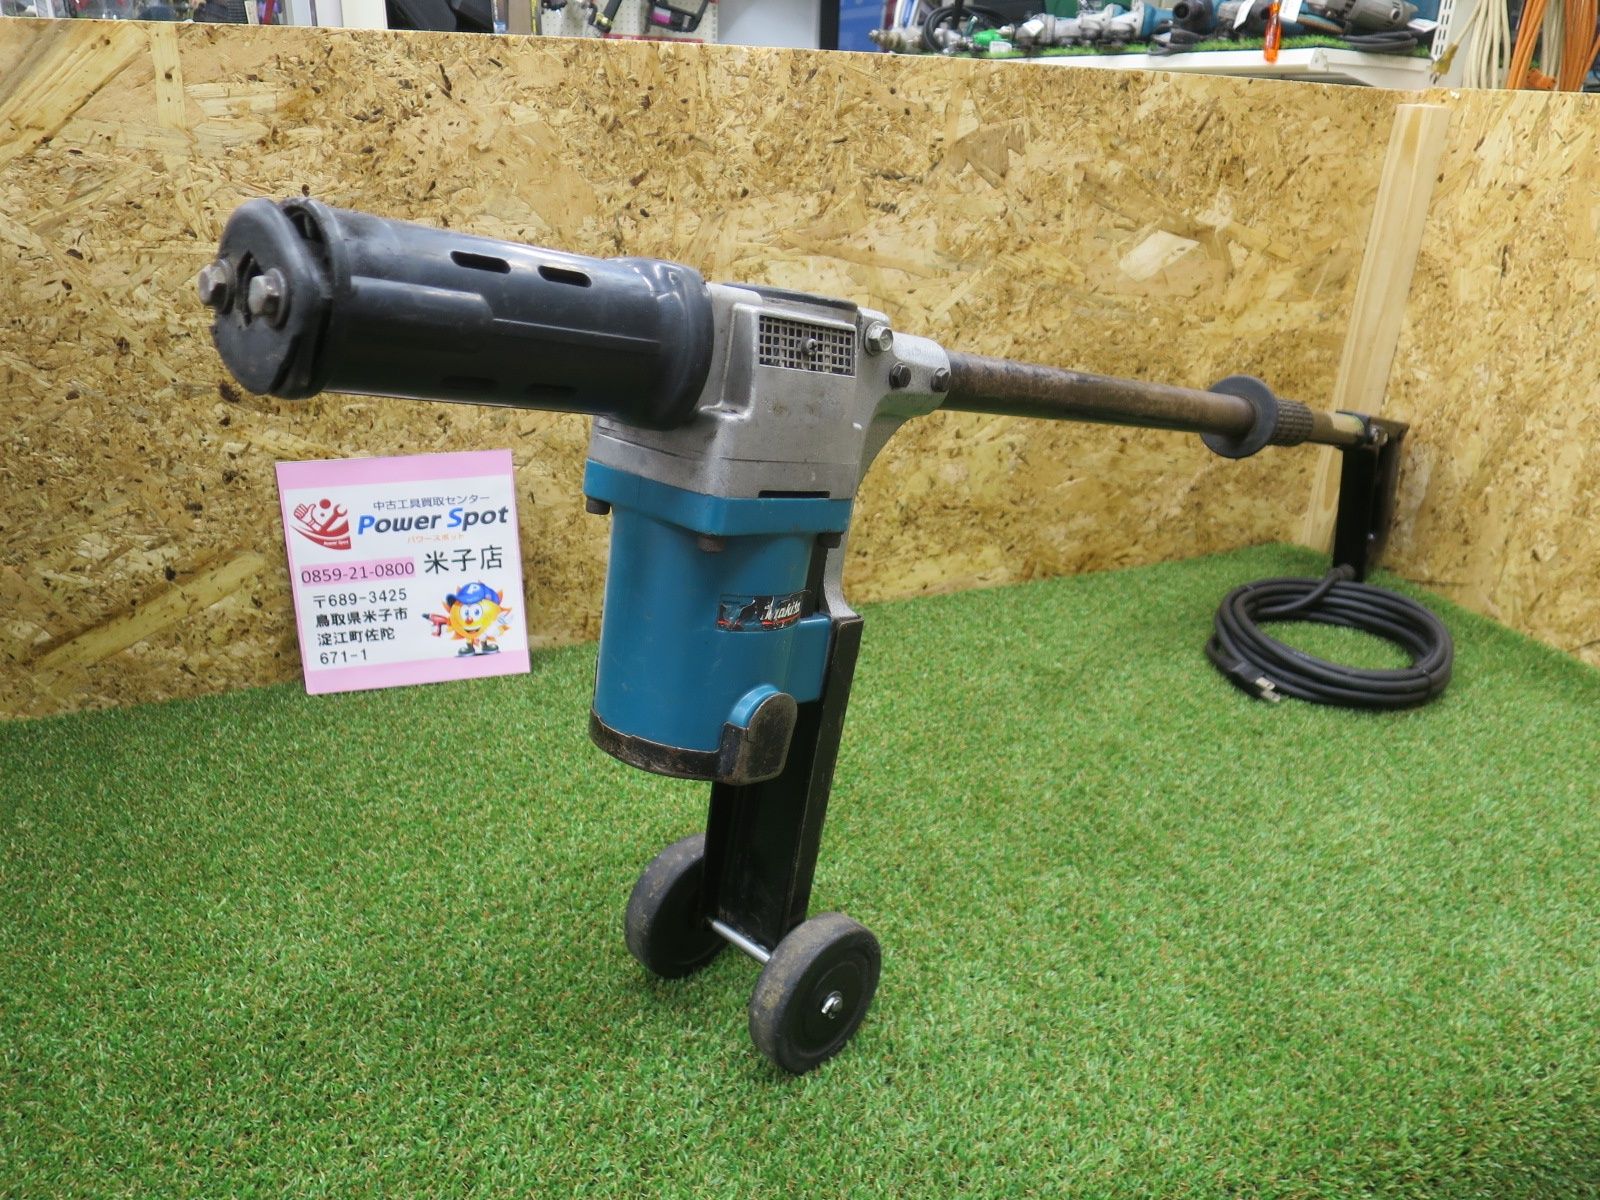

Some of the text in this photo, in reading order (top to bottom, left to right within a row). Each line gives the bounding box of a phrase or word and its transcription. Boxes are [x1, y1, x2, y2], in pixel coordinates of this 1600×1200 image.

[373, 495, 490, 511] 中古工具買取センター
[357, 505, 509, 535] Power Spot
[424, 545, 503, 574] 米子店
[301, 561, 415, 584] 0859-21-0800
[316, 607, 409, 629] 鳥取県米子市
[318, 627, 396, 647] 淀江町佐陀
[319, 649, 368, 666] 671-1
